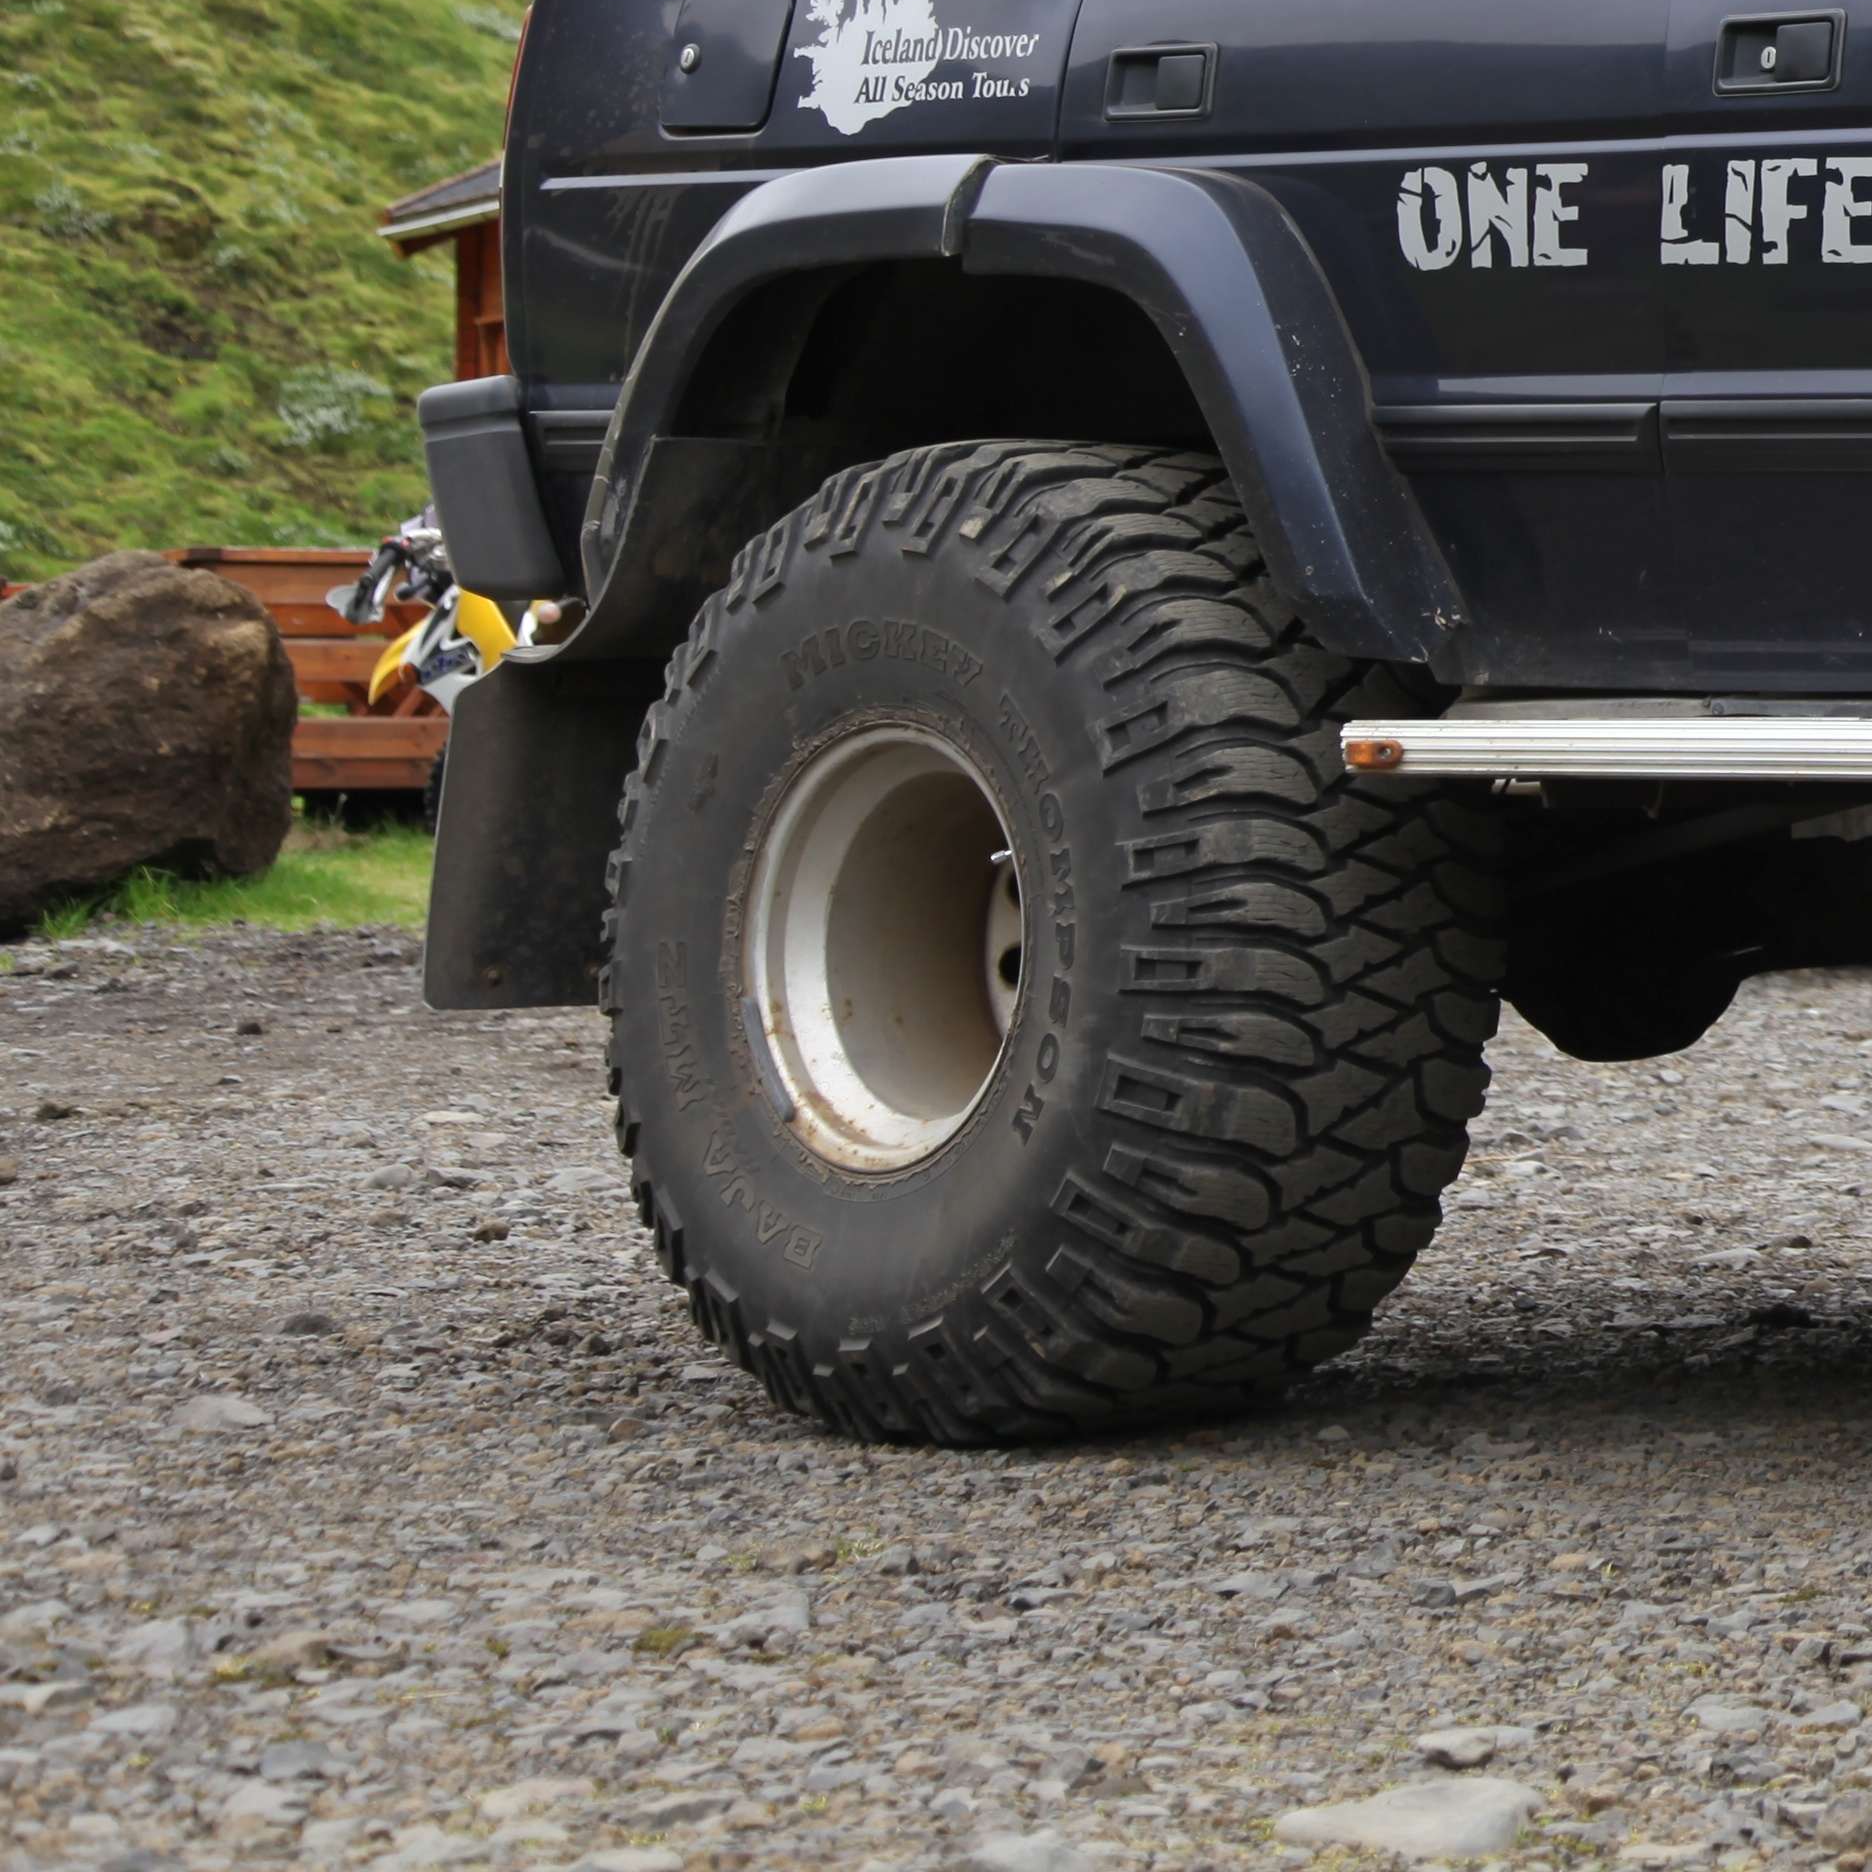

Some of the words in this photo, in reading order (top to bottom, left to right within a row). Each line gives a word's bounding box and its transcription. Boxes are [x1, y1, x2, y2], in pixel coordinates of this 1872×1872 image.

[860, 28, 939, 65] Iceland
[943, 26, 1040, 61] Discover
[854, 75, 888, 104] All
[892, 75, 964, 102] Season
[1398, 162, 1588, 270] ONE
[780, 620, 984, 690] MICKEY
